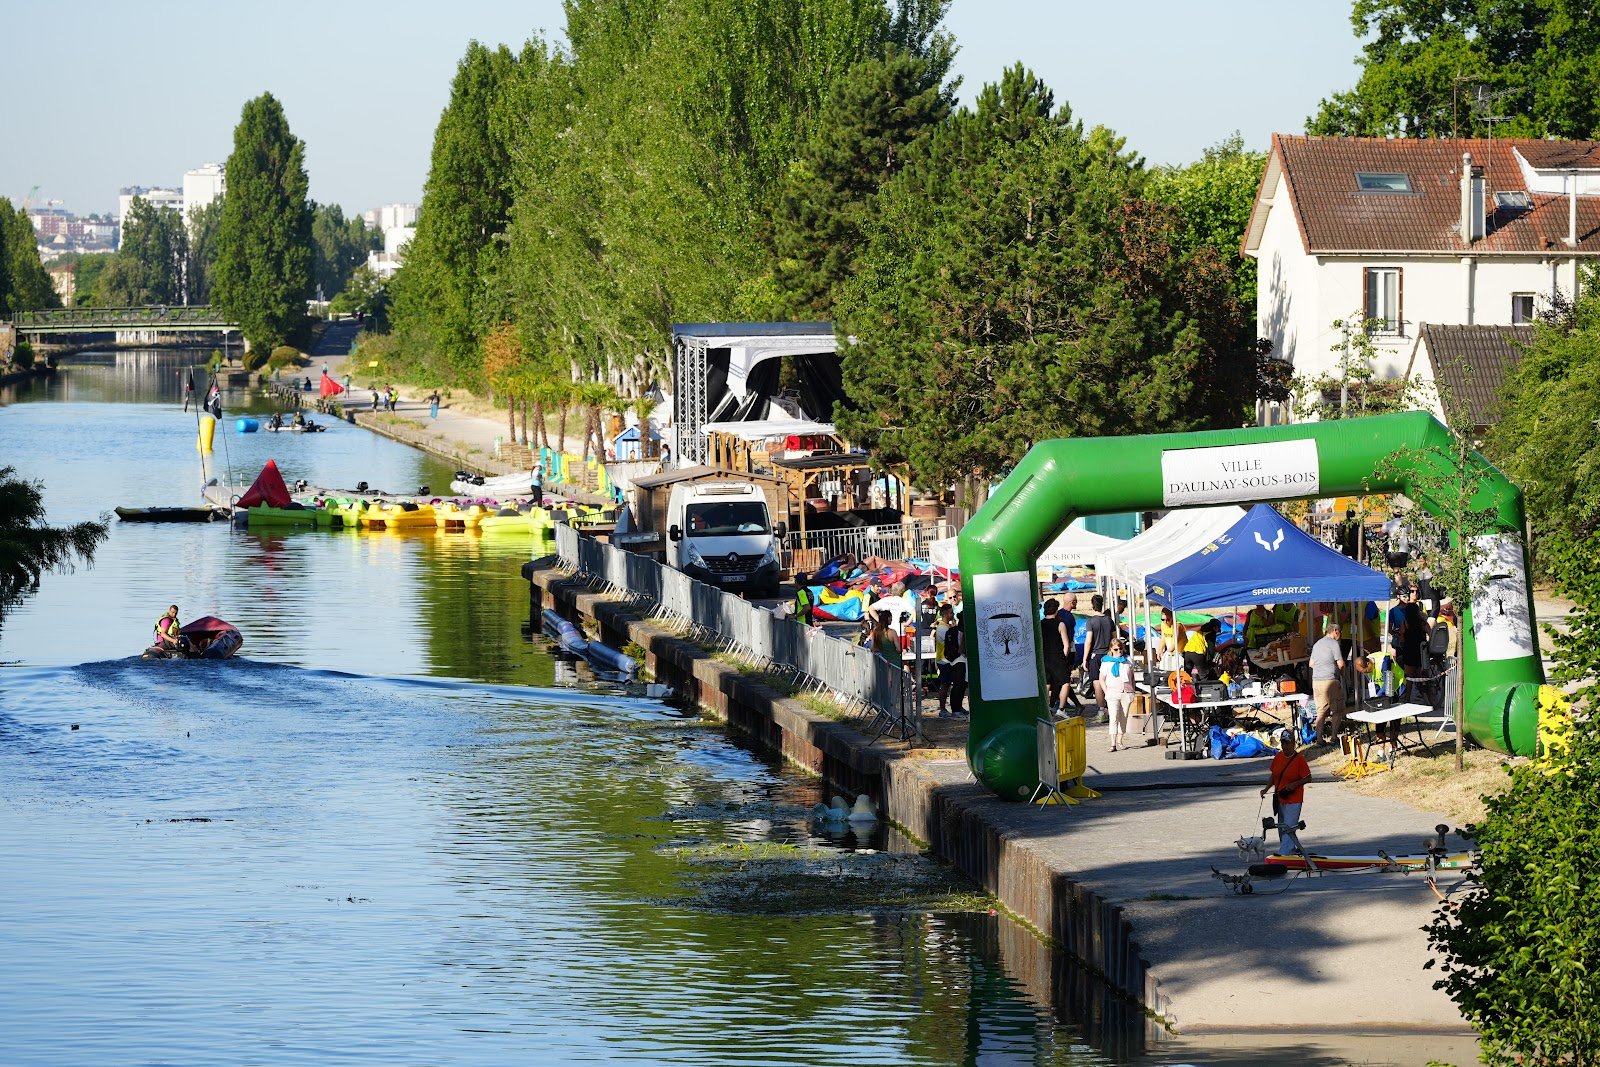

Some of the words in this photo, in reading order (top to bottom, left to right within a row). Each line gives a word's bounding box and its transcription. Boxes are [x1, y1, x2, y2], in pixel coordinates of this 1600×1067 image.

[1221, 459, 1262, 472] VILLE
[1169, 472, 1316, 494] D'AULNAY-SOUS-BOIS
[1252, 586, 1311, 596] SPRINGART.CC
